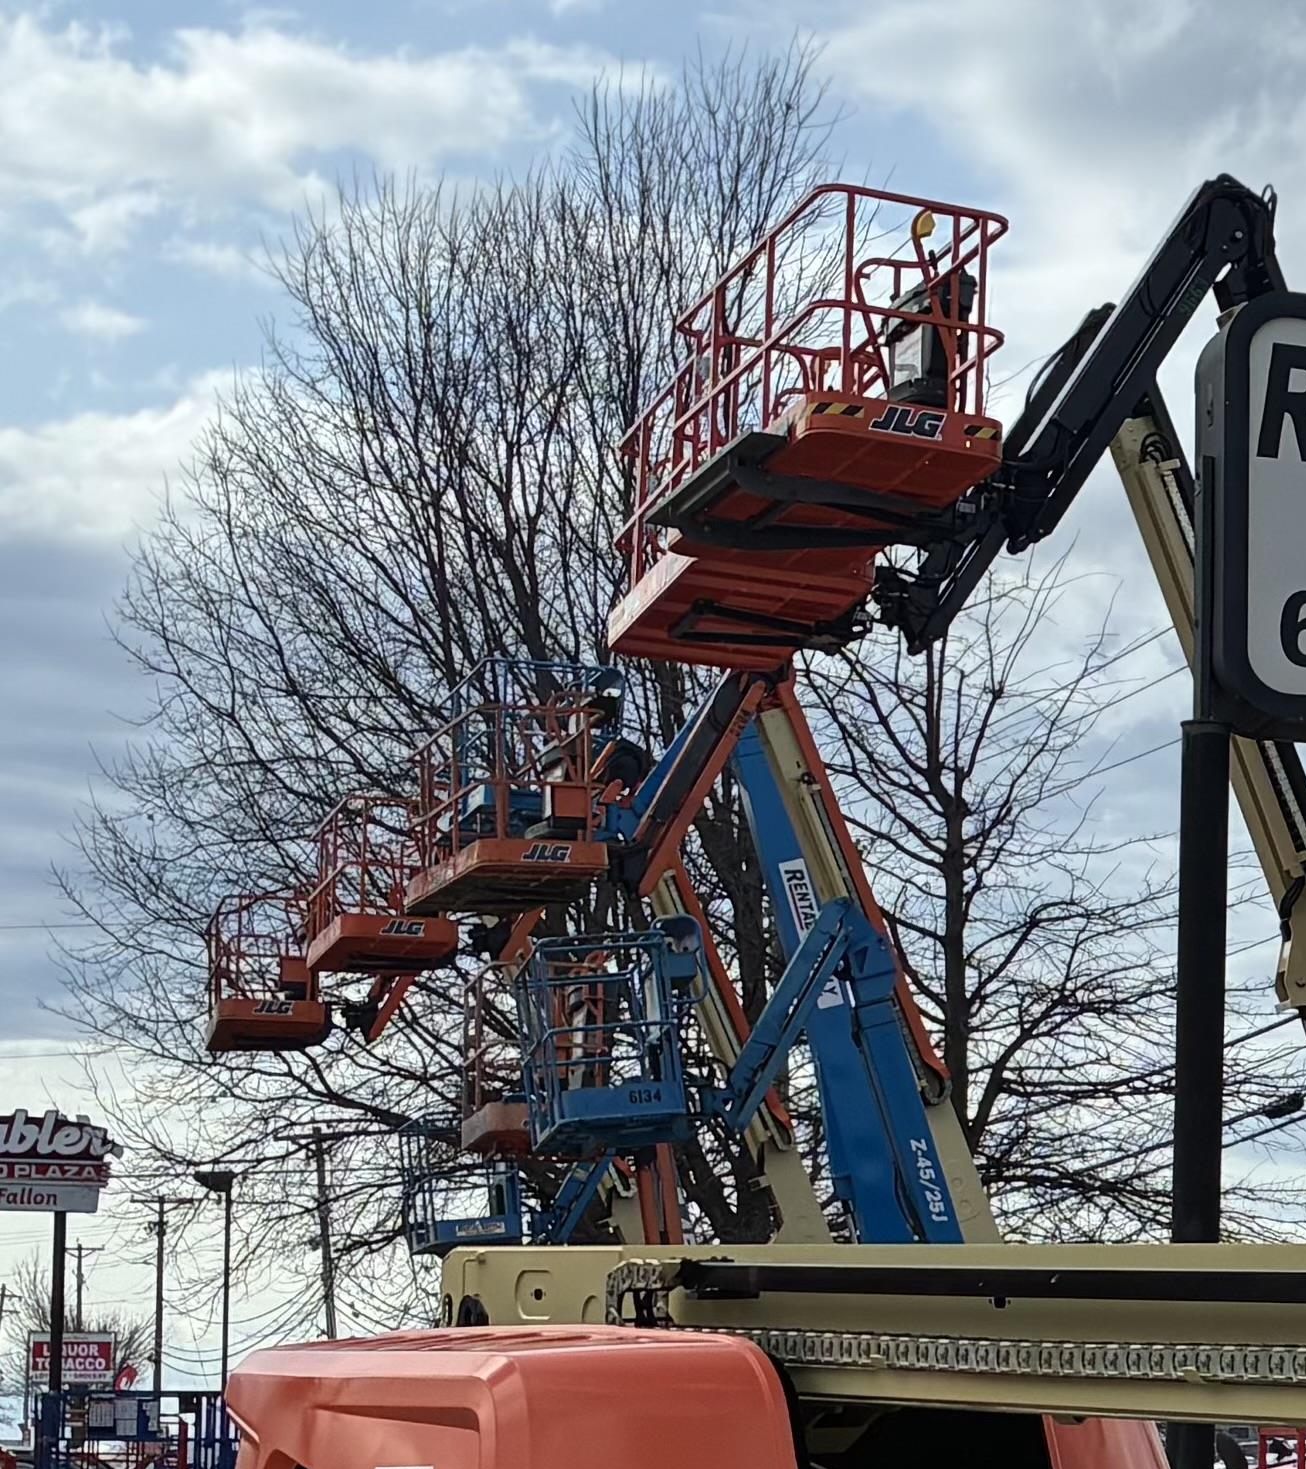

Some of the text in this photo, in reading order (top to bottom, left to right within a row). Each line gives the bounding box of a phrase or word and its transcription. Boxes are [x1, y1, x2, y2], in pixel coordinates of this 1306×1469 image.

[868, 404, 948, 440] JLG
[521, 843, 572, 863] JLG
[380, 919, 425, 937] JLG
[254, 1000, 294, 1016] JLG
[629, 1088, 662, 1105] 6134
[14, 1164, 98, 1179] PLAZA
[909, 1137, 949, 1224] Z-45/25J
